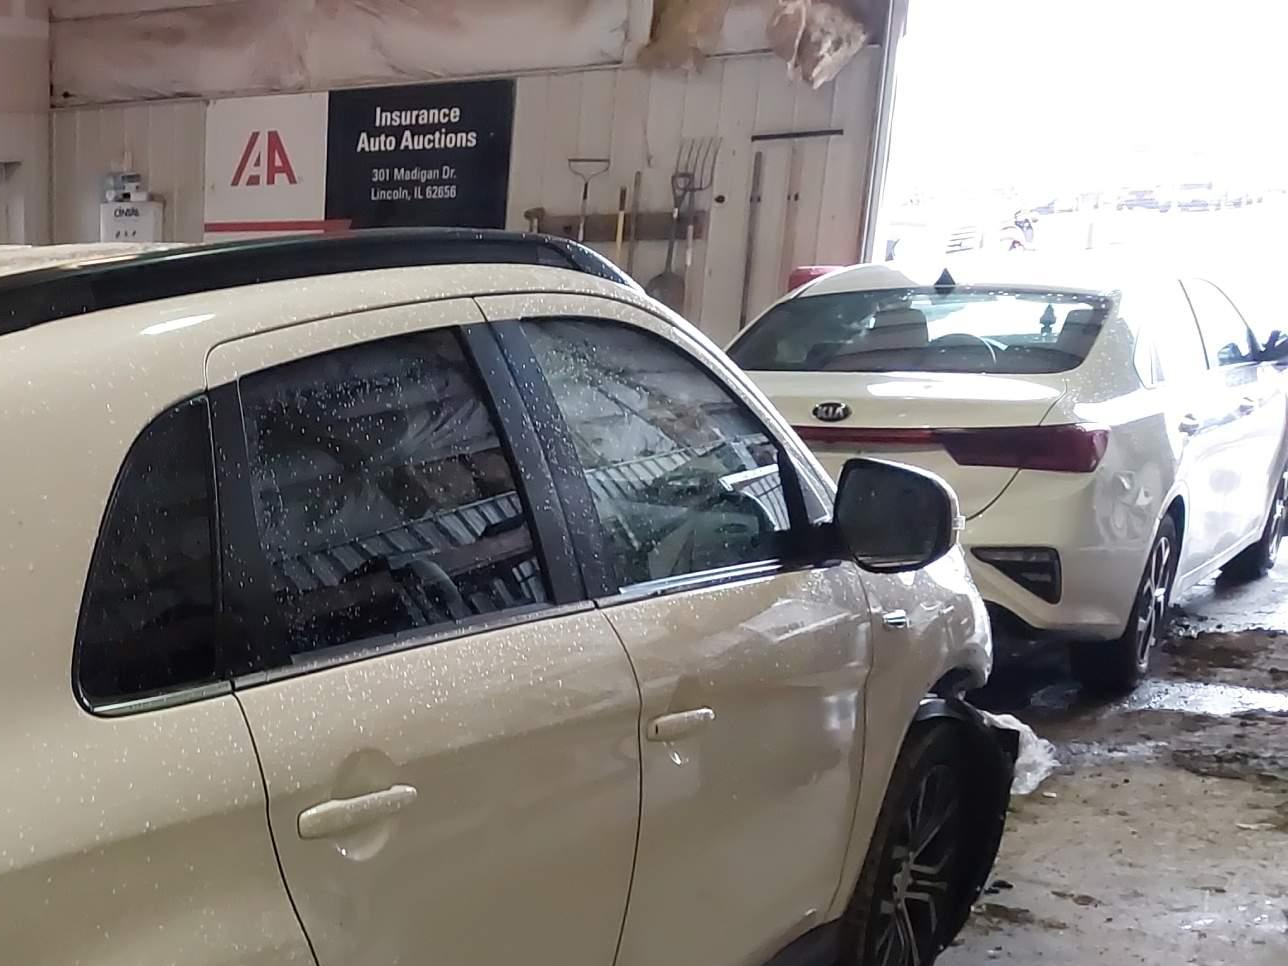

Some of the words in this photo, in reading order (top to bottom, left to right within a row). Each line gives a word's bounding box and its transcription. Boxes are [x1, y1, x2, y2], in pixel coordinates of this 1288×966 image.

[375, 106, 460, 127] Insurance
[356, 131, 396, 152] Auto
[399, 128, 477, 150] Auctions
[371, 168, 391, 182] 301
[393, 166, 440, 183] Madigan
[441, 165, 457, 180] Dr.
[370, 186, 411, 201] Lincoln,
[413, 186, 424, 199] IL
[425, 184, 457, 199] 62656
[816, 405, 846, 418] KIA
